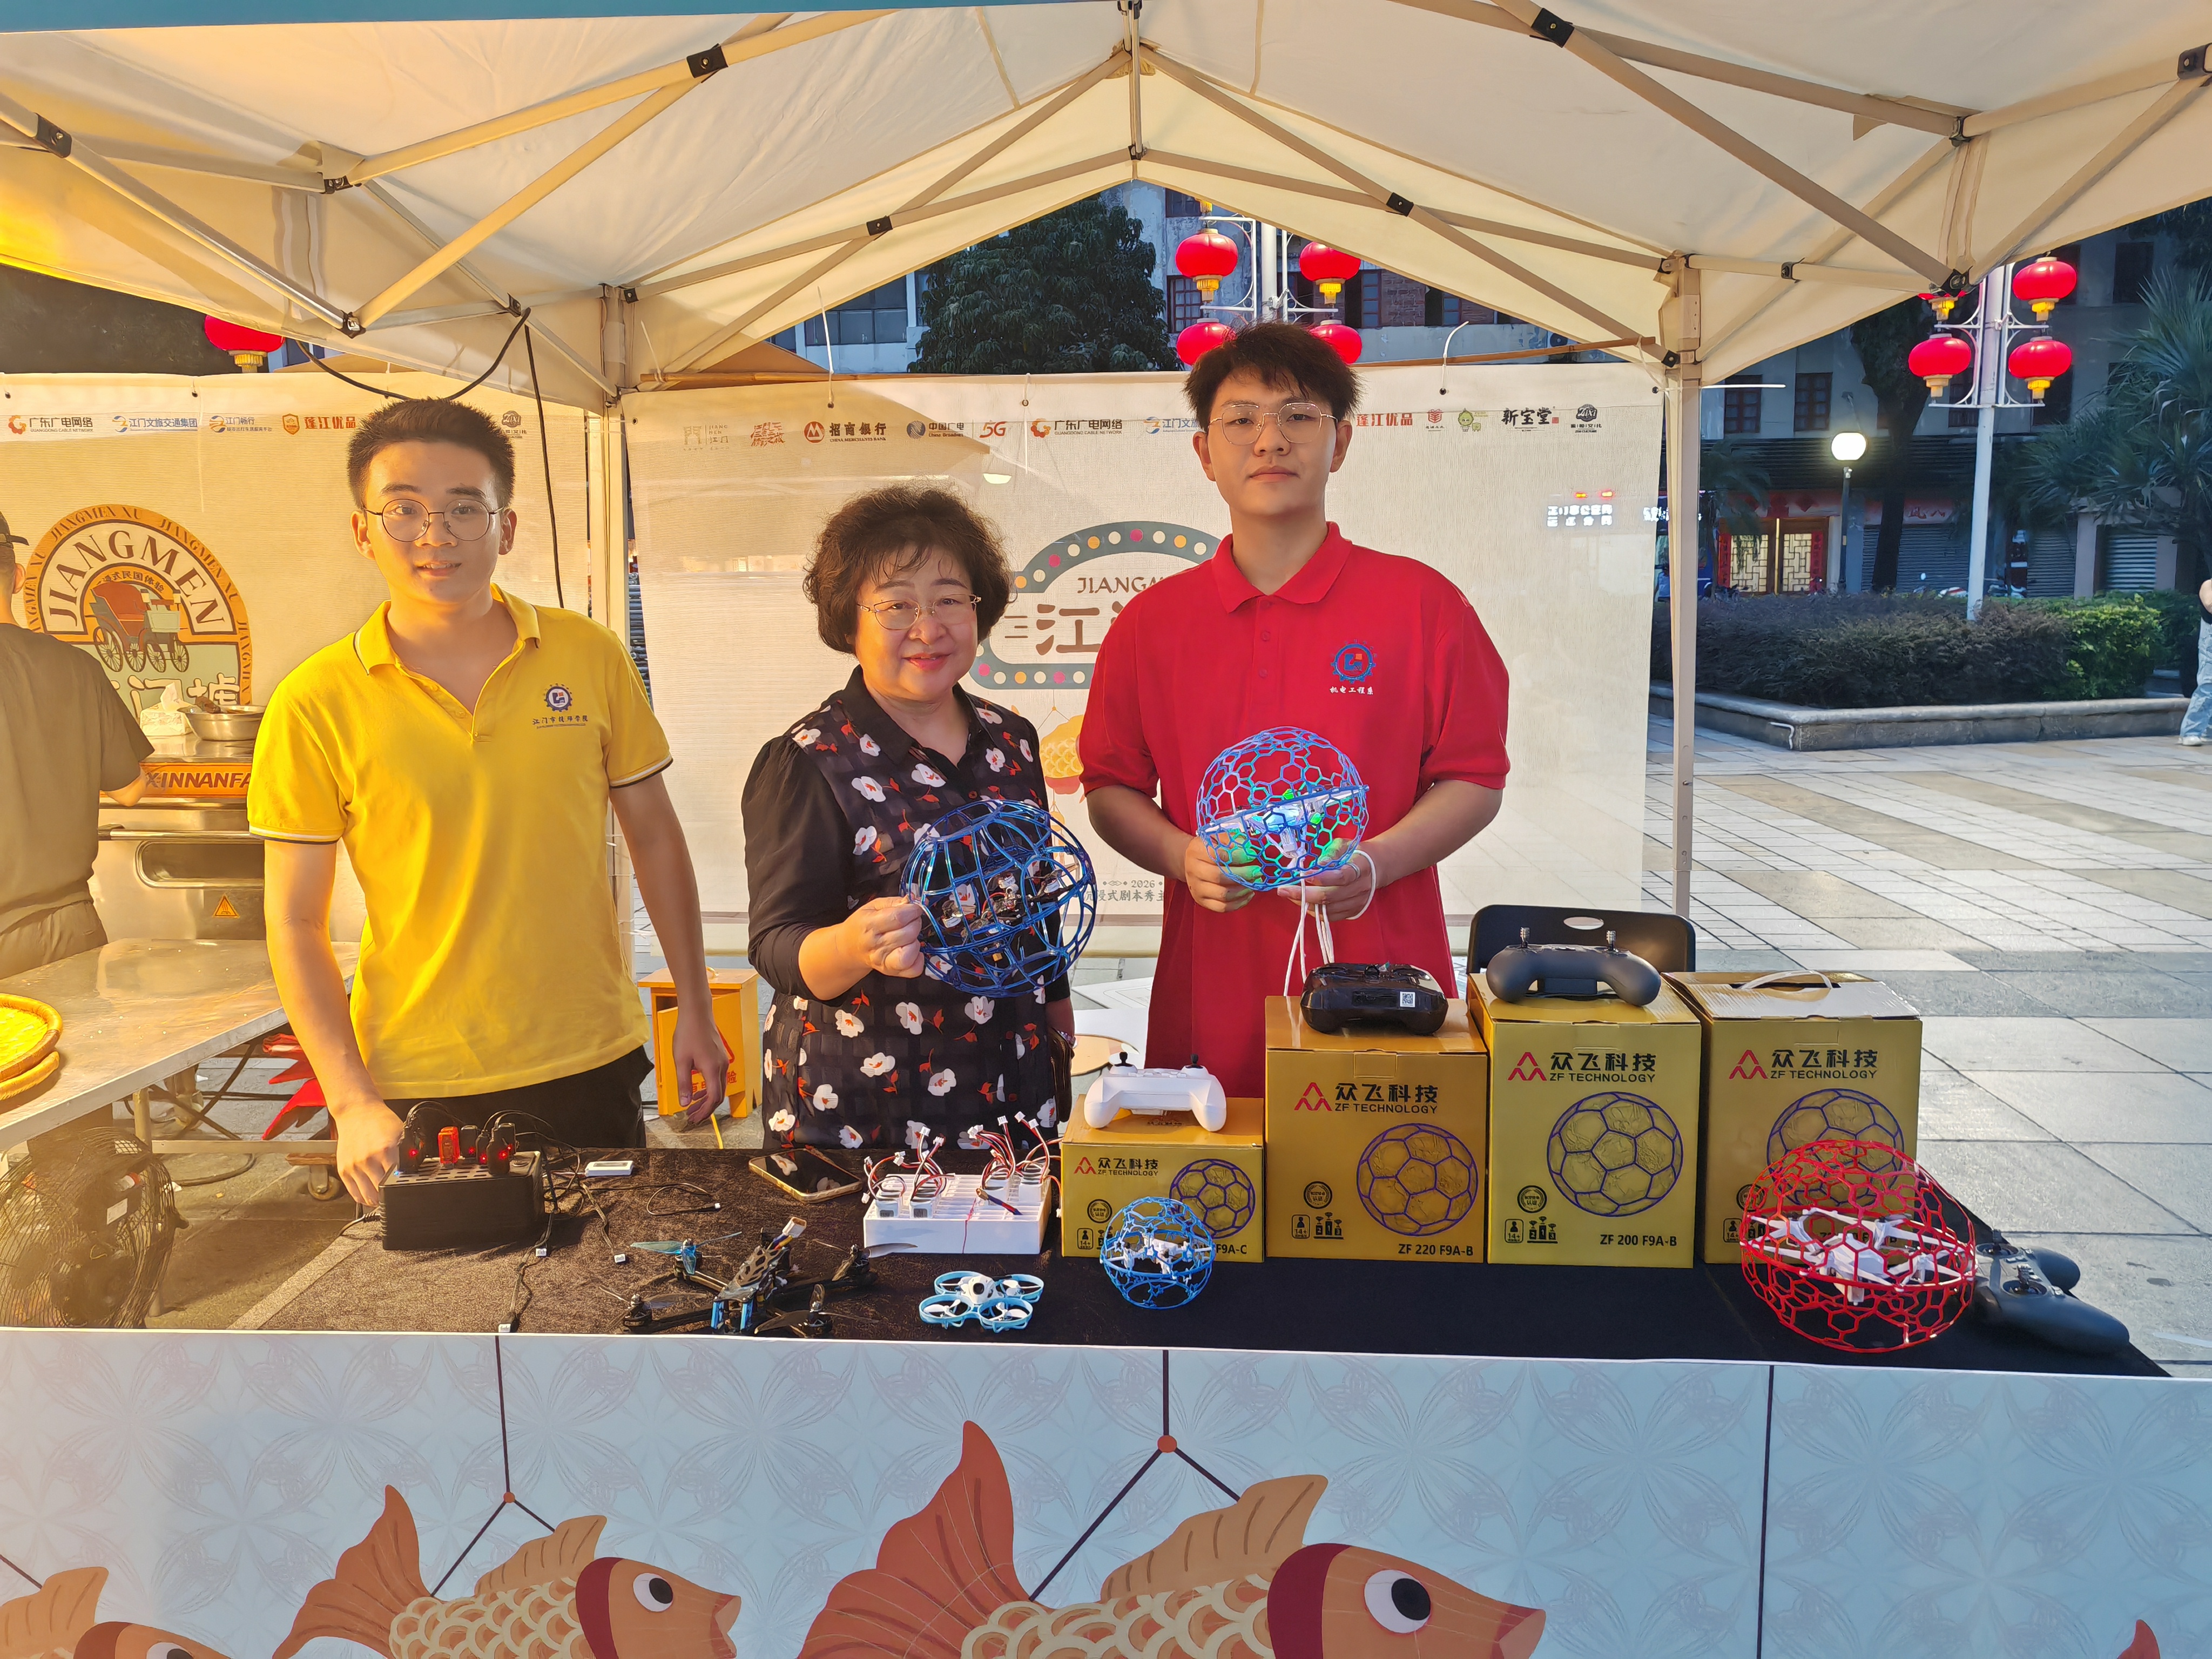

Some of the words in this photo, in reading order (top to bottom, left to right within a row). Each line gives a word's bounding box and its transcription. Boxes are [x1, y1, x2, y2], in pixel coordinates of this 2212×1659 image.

[29, 417, 93, 428] 广东广电网络
[129, 417, 198, 428] 江门文旅交通集团
[226, 417, 255, 425] 江门畅行
[305, 416, 356, 429] 蓬江优品
[1356, 413, 1413, 427] 蓬江优品
[1501, 408, 1552, 427] 新宝堂
[829, 422, 887, 437] 招商银行
[928, 422, 965, 431] 中国广电
[979, 420, 1007, 439] 5G
[1054, 419, 1123, 430] 广东广电网络
[49, 530, 225, 627] JIANGMEN
[1330, 685, 1374, 695] 机电工程系
[532, 715, 589, 725] 江门市技师学院
[1131, 880, 1156, 888] 2026
[1549, 1052, 1657, 1072] 众飞科技
[1771, 1049, 1878, 1068] 众飞科技
[1549, 1073, 1565, 1081] ZF
[1570, 1073, 1656, 1083] TECHNOLOGY
[1771, 1070, 1786, 1078] ZF
[1790, 1070, 1878, 1080] TECHNOLOGY
[1334, 1082, 1438, 1104] 众飞科技
[1334, 1103, 1350, 1111] ZF
[1354, 1103, 1438, 1114] TECHNOLOGY
[1098, 1157, 1159, 1170] 众飞科技
[1600, 1235, 1614, 1245] ZF
[1618, 1235, 1638, 1245] 200
[1642, 1235, 1677, 1246] F9A-B
[1216, 1244, 1247, 1255] F9A-C
[1398, 1244, 1412, 1255] ZF
[1415, 1244, 1437, 1255] 220
[1439, 1245, 1474, 1256] F9A-B
